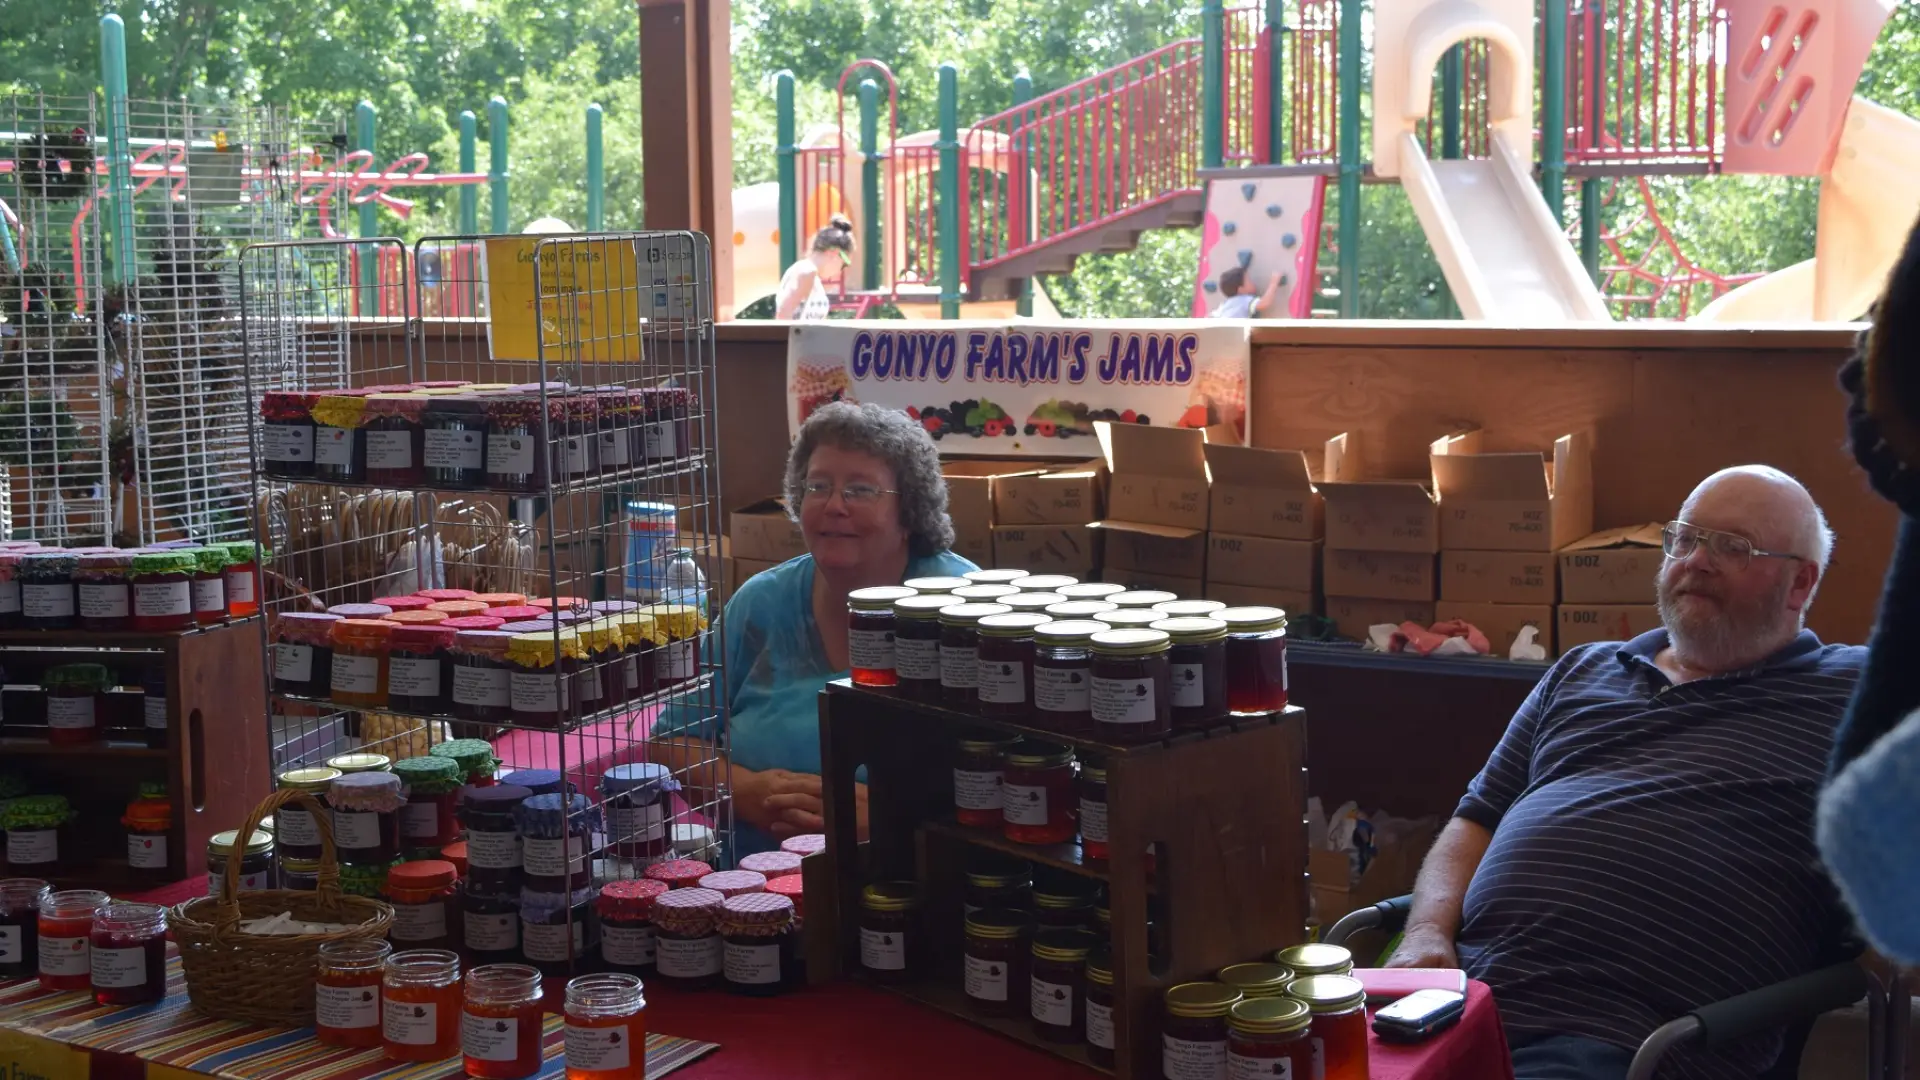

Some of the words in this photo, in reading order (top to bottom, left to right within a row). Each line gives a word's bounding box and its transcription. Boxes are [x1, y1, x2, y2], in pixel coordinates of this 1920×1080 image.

[852, 331, 957, 381] GONYO
[964, 331, 1091, 385] FARM'S
[1098, 332, 1200, 386] JAMS
[1508, 523, 1543, 532] 70-400
[1565, 556, 1570, 567] 1
[1575, 555, 1600, 567] DOZ
[1563, 612, 1568, 623] 1
[1573, 611, 1598, 623] DOZ
